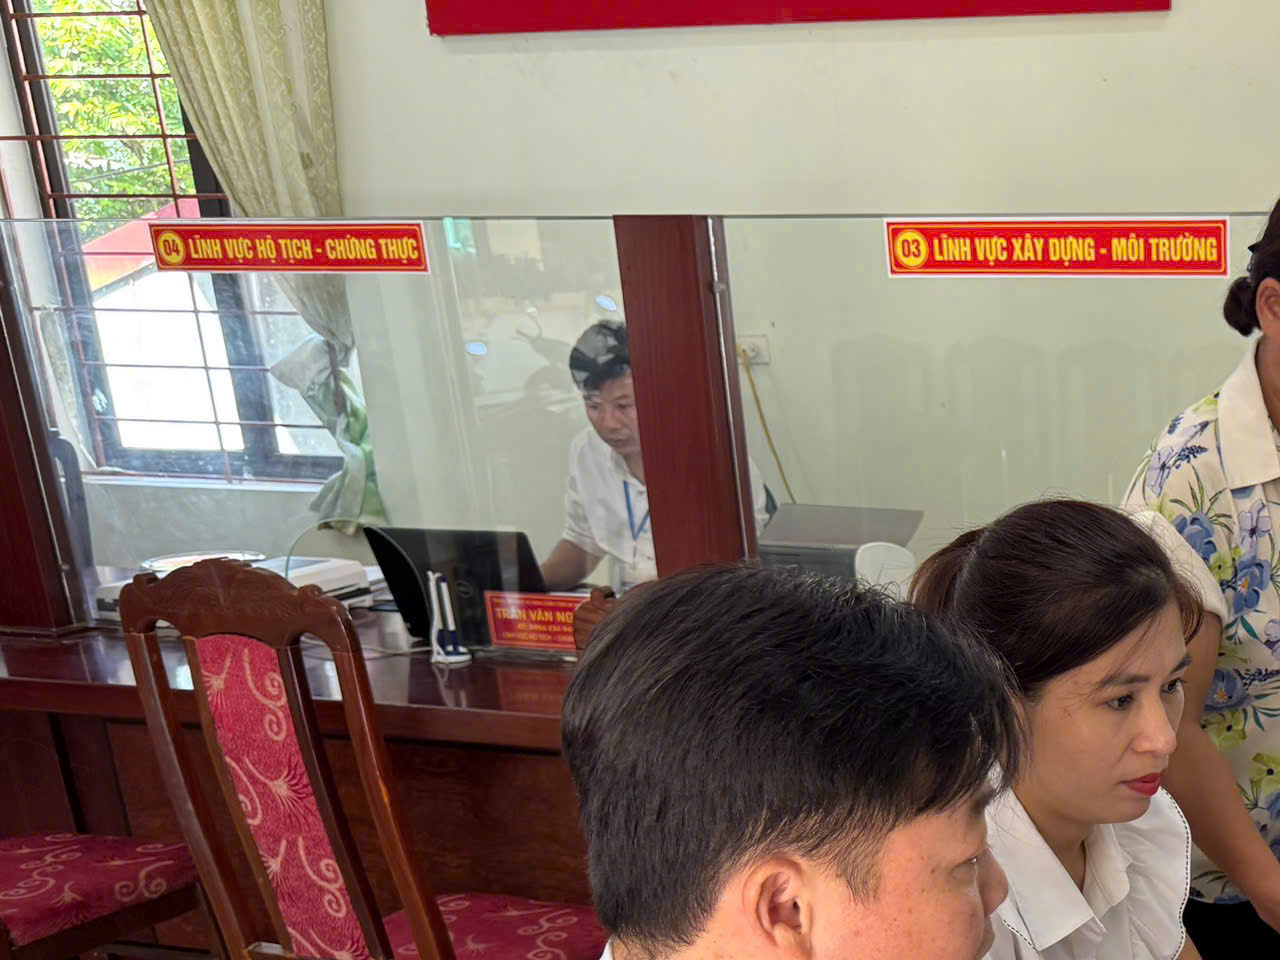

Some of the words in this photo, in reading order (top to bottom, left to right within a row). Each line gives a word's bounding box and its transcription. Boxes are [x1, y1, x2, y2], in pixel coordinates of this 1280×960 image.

[163, 239, 182, 257] 04
[189, 235, 221, 260] LĨNH
[224, 238, 254, 263] VỰC
[255, 235, 277, 263] HỘ
[278, 238, 313, 263] TỊCH
[327, 235, 377, 260] CHỨNG
[378, 236, 419, 264] THỰC
[901, 240, 921, 258] 03
[933, 234, 970, 262] LĨNH
[975, 237, 1008, 266] VỰC
[1012, 233, 1044, 262] XÂY
[1049, 237, 1096, 266] DỰNG
[1111, 233, 1144, 261] MÔI
[1148, 232, 1218, 262] TRƯỜNG
